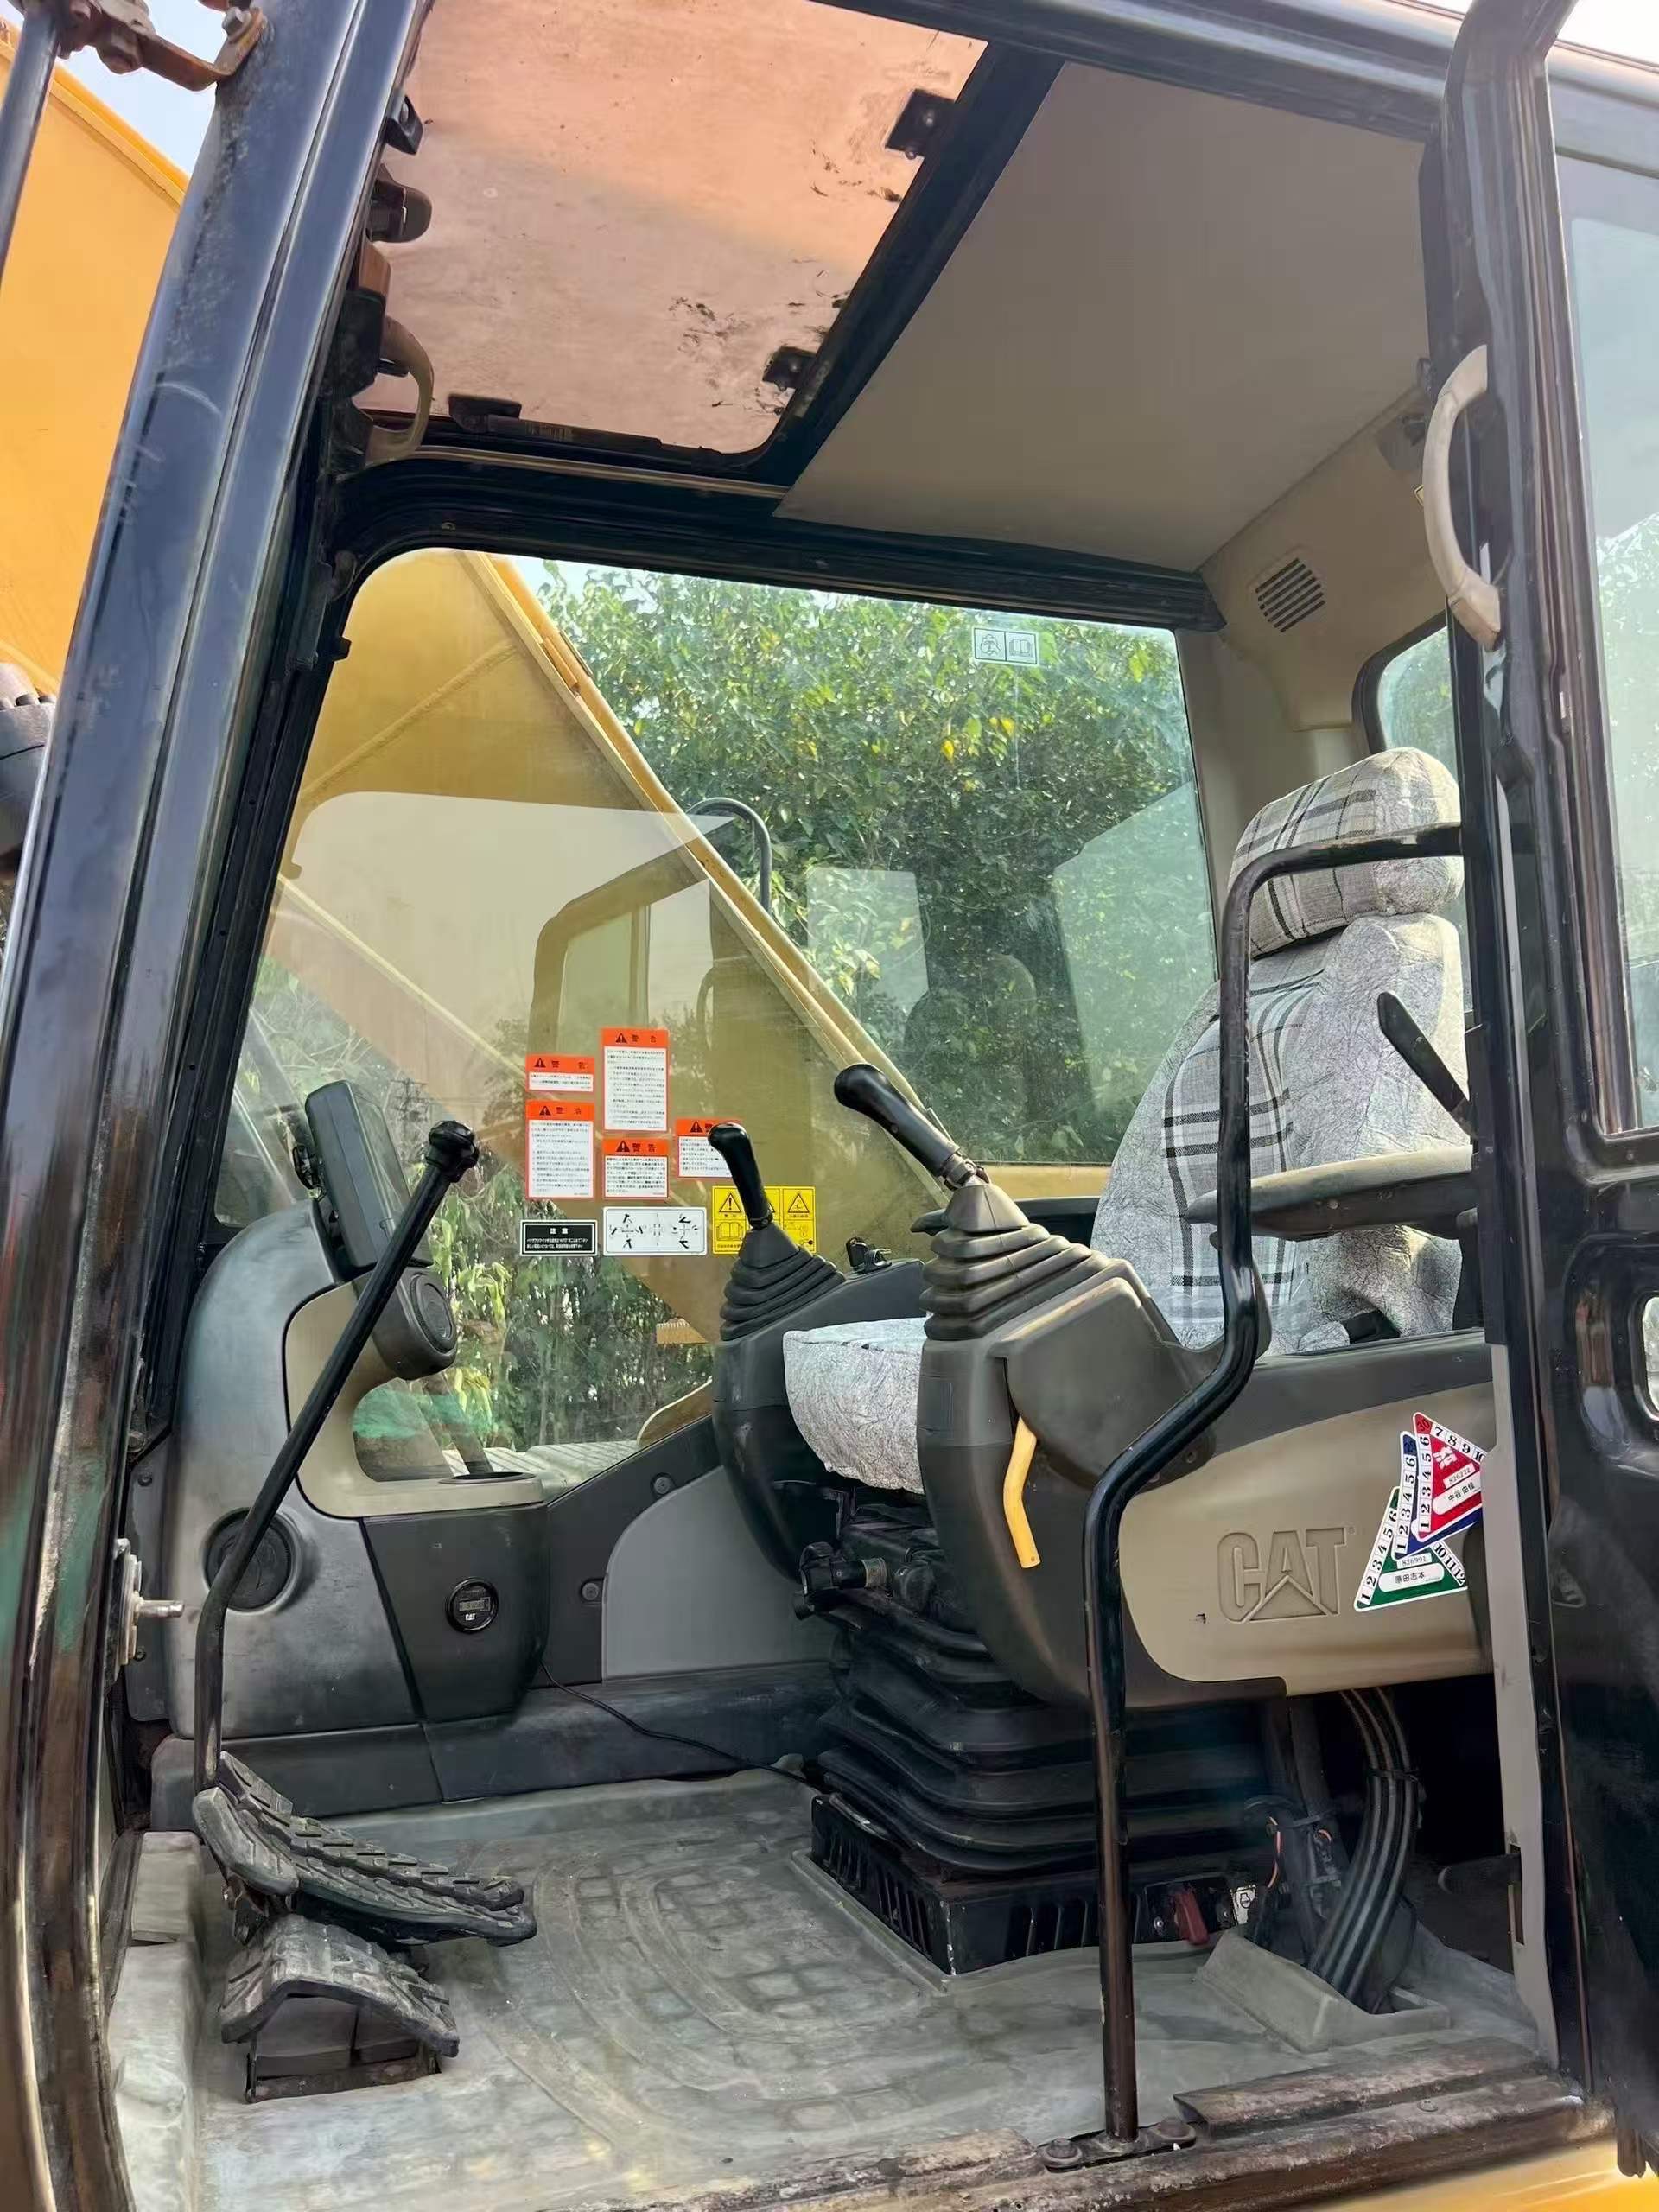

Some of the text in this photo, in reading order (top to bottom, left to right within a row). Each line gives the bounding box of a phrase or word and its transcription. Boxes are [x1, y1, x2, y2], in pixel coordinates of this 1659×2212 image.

[1420, 1436, 1429, 1446] 6
[1434, 1426, 1443, 1436] 7
[1447, 1435, 1457, 1446] 8
[1462, 1443, 1471, 1453] 9
[1406, 1458, 1415, 1467] 6
[1421, 1453, 1432, 1462] 5
[1405, 1474, 1414, 1484] 5
[1422, 1471, 1431, 1480] 4
[1422, 1487, 1431, 1497] 3
[1403, 1493, 1413, 1502] 4
[1402, 1508, 1411, 1518] 3
[1421, 1503, 1430, 1513] 2
[1399, 1525, 1408, 1535] 2
[1366, 1576, 1376, 1586] 2
[1372, 1560, 1382, 1571] 3
[1378, 1545, 1387, 1555] 4
[1383, 1528, 1393, 1538] 5
[1389, 1511, 1397, 1522] 6
[1434, 1544, 1465, 1583] 10 11 12
[1217, 1527, 1345, 1624] CAT
